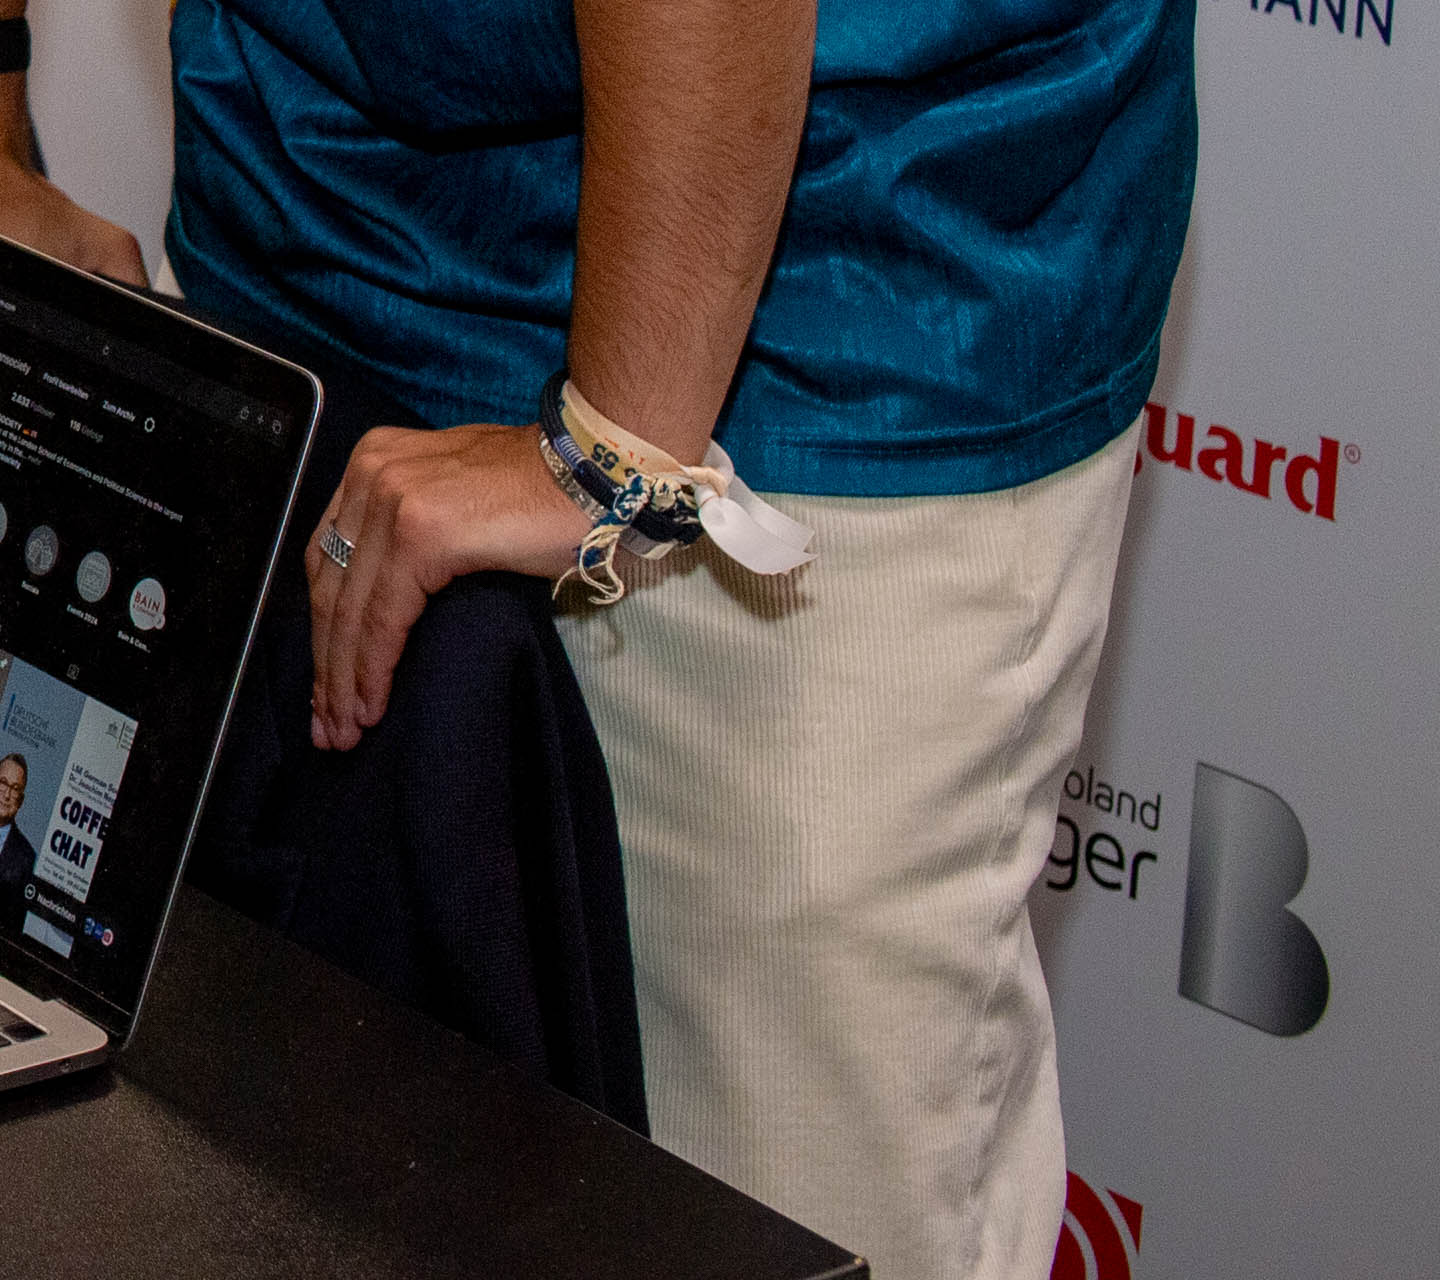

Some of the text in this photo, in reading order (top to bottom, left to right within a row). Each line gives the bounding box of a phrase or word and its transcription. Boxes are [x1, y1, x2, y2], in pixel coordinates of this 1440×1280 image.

[116, 407, 136, 422] Archiv
[1135, 401, 1340, 522] uard
[134, 591, 160, 613] BAIN
[57, 793, 110, 842] COFFE
[1064, 766, 1161, 833] oland
[47, 826, 93, 872] CHAT
[1046, 815, 1158, 900] ger
[37, 893, 76, 922] Nachrichten
